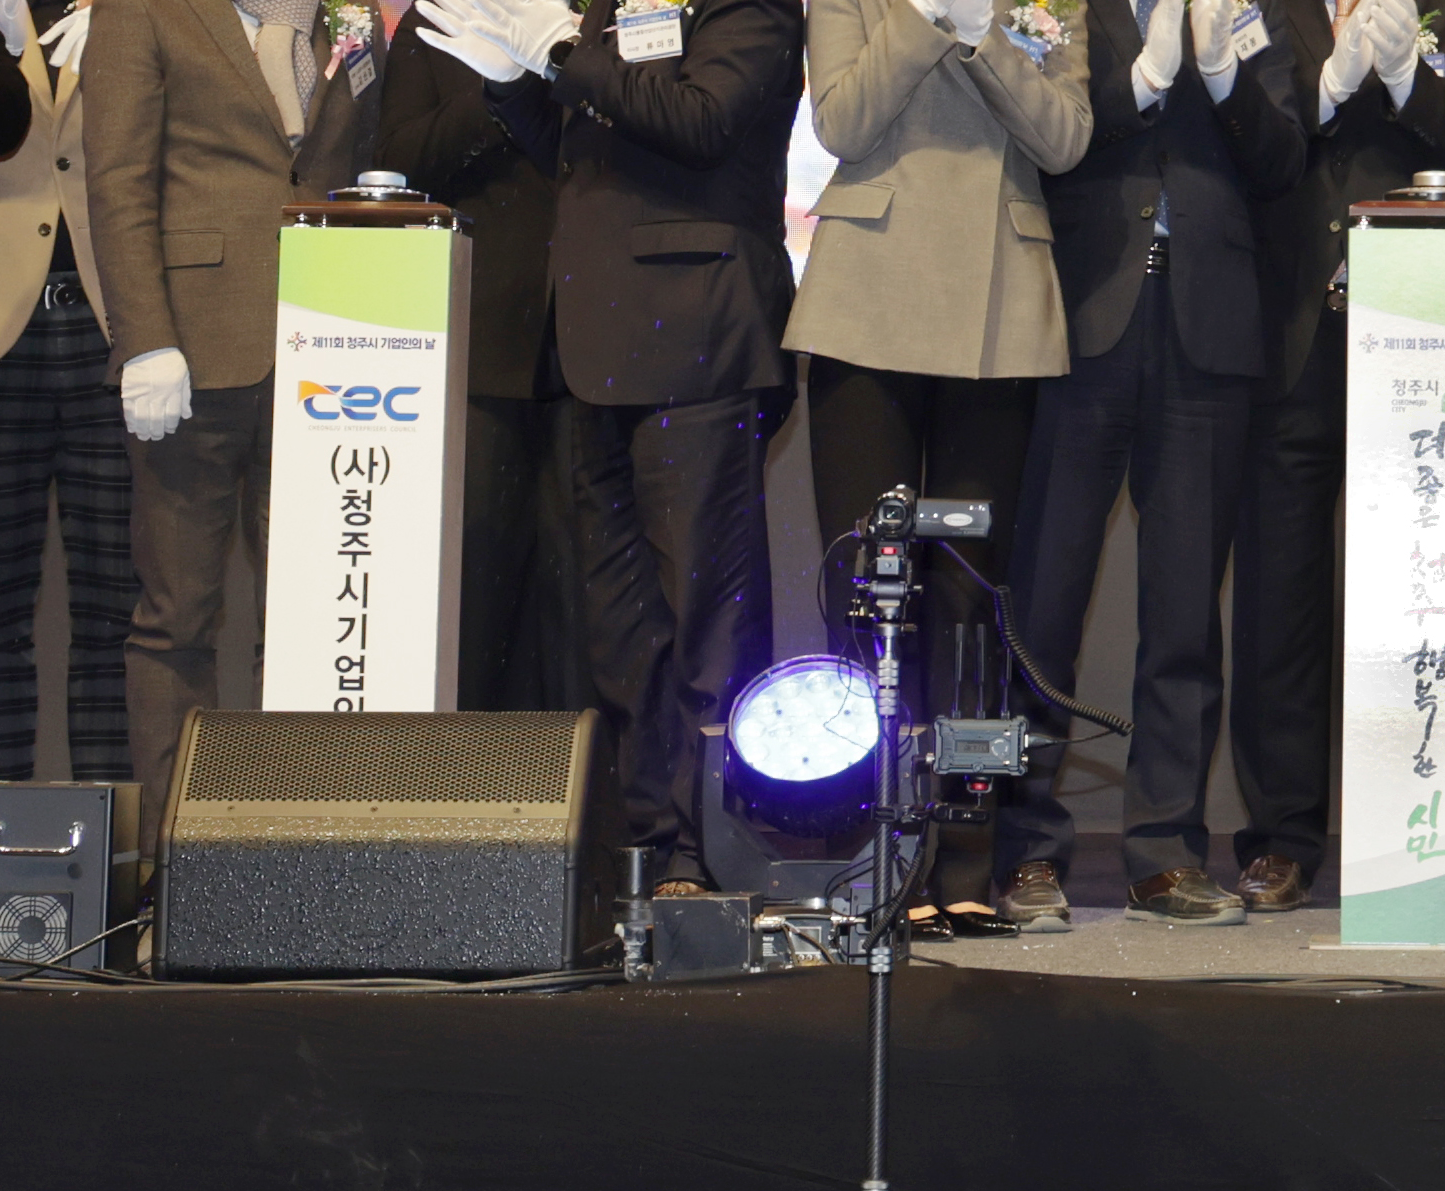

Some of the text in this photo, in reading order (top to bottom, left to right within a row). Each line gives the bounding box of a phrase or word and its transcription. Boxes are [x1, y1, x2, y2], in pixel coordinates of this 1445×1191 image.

[312, 336, 436, 350] 제11회 청주시 기업인의 날
[1383, 337, 1416, 350] 제11회
[1391, 379, 1439, 397] 청주시
[1412, 465, 1444, 528] 좋은
